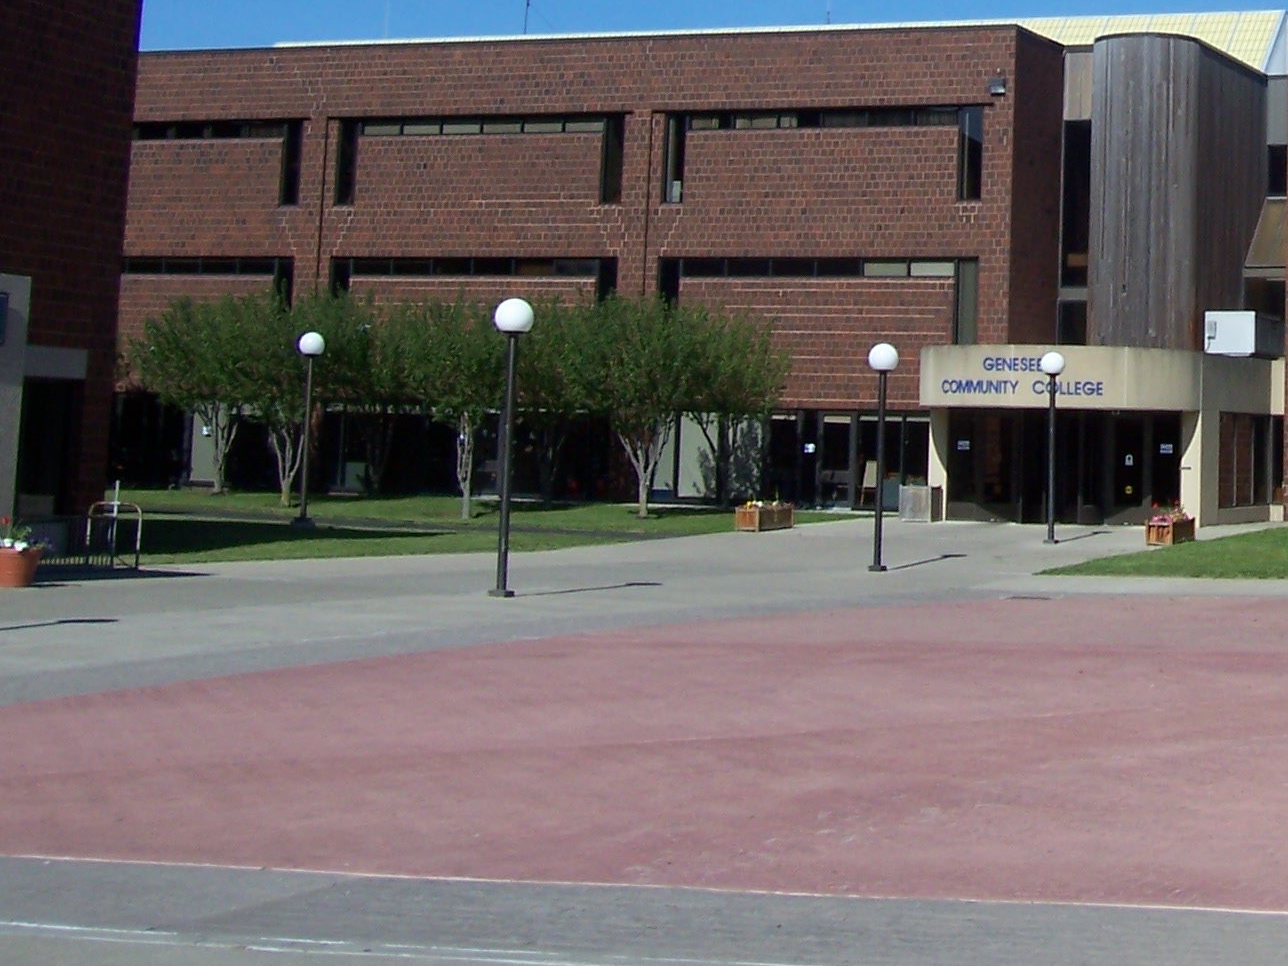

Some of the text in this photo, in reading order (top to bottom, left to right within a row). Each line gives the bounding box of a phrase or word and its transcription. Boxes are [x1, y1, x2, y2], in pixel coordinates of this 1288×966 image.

[983, 357, 1043, 371] GENESEE
[942, 380, 1103, 395] COMMUNITY COLLEGE
